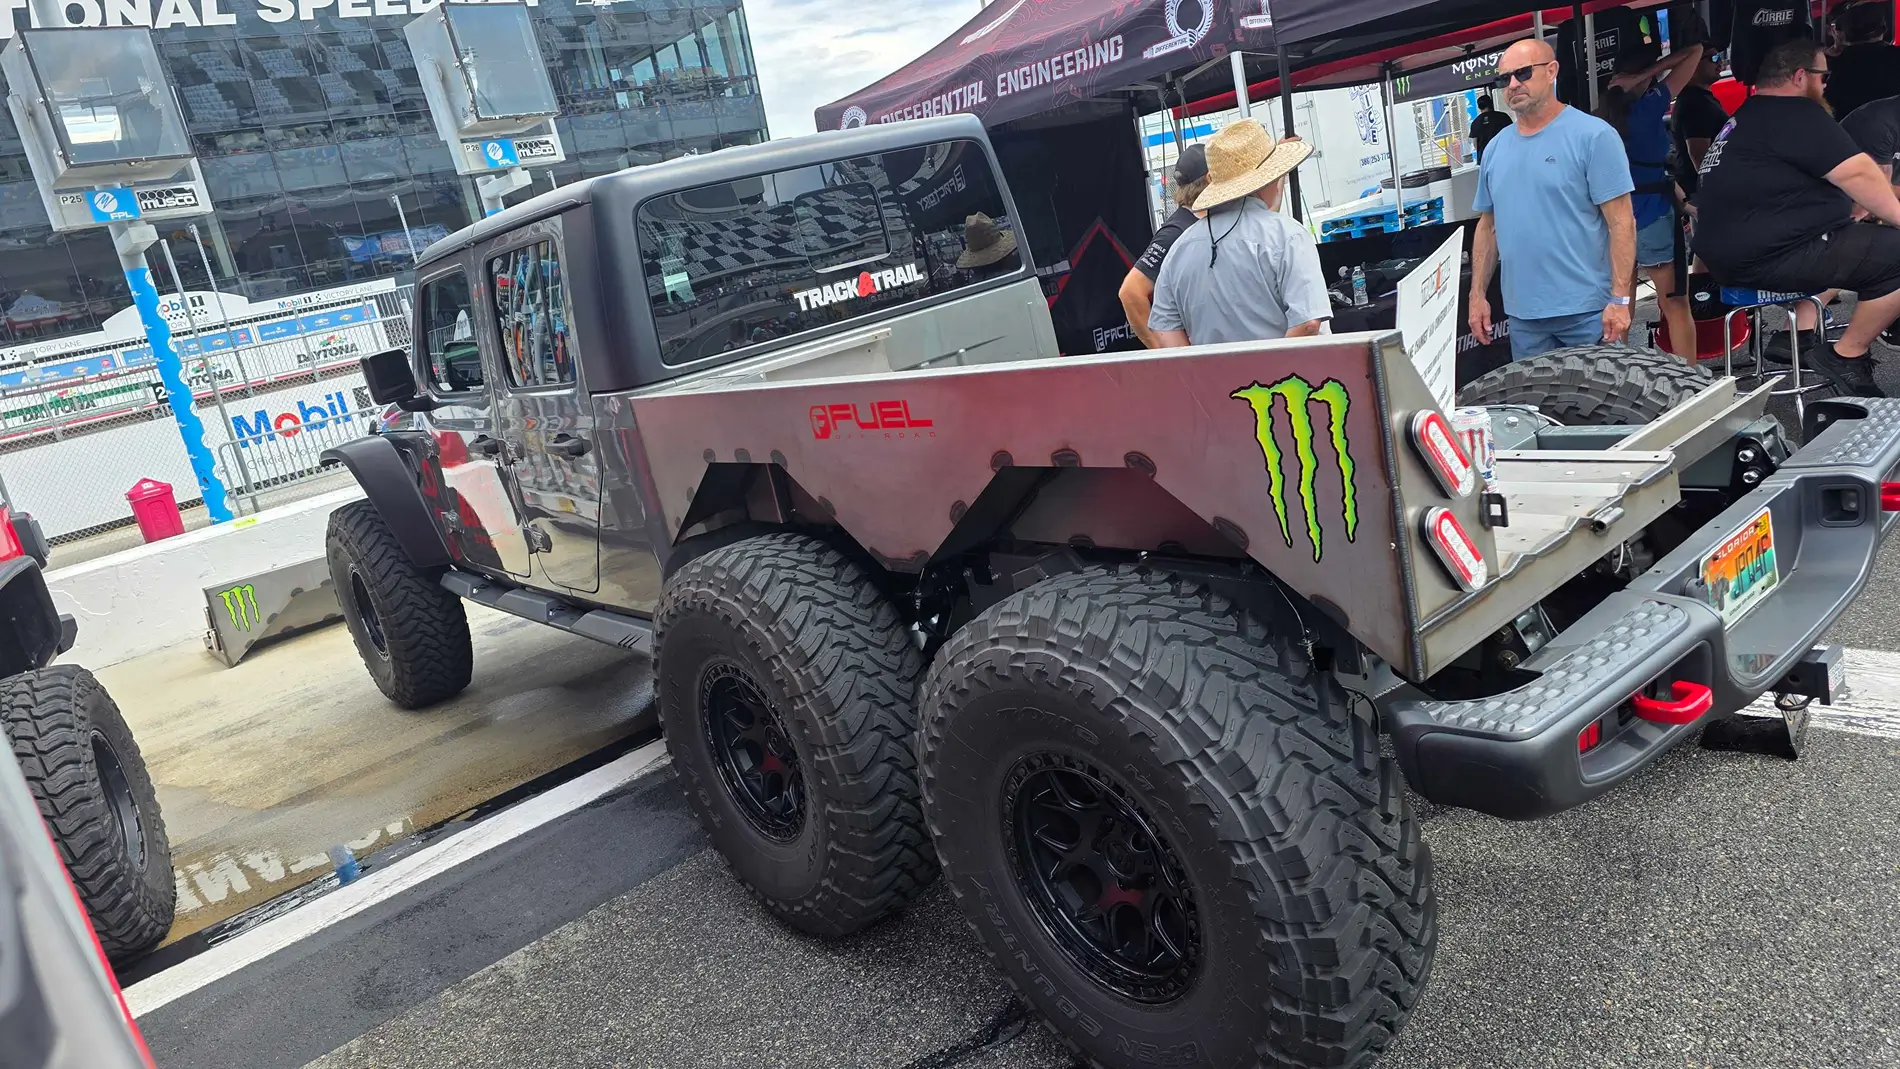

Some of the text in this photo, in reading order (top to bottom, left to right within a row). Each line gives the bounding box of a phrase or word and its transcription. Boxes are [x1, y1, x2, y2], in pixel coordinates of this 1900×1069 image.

[1753, 9, 1793, 25] CURRIE
[1155, 38, 1188, 53] DIFFERENTIAL
[997, 35, 1124, 96] ENGINEERING
[1452, 52, 1504, 74] MONST
[1465, 69, 1499, 81] ENER
[278, 298, 302, 309] Mobil
[324, 289, 354, 300] VICTORY
[58, 339, 82, 350] LANE
[1104, 321, 1135, 346] FACT
[232, 391, 352, 448] Mobil
[827, 399, 934, 431] FUEL
[1716, 526, 1757, 562] FLORIDA
